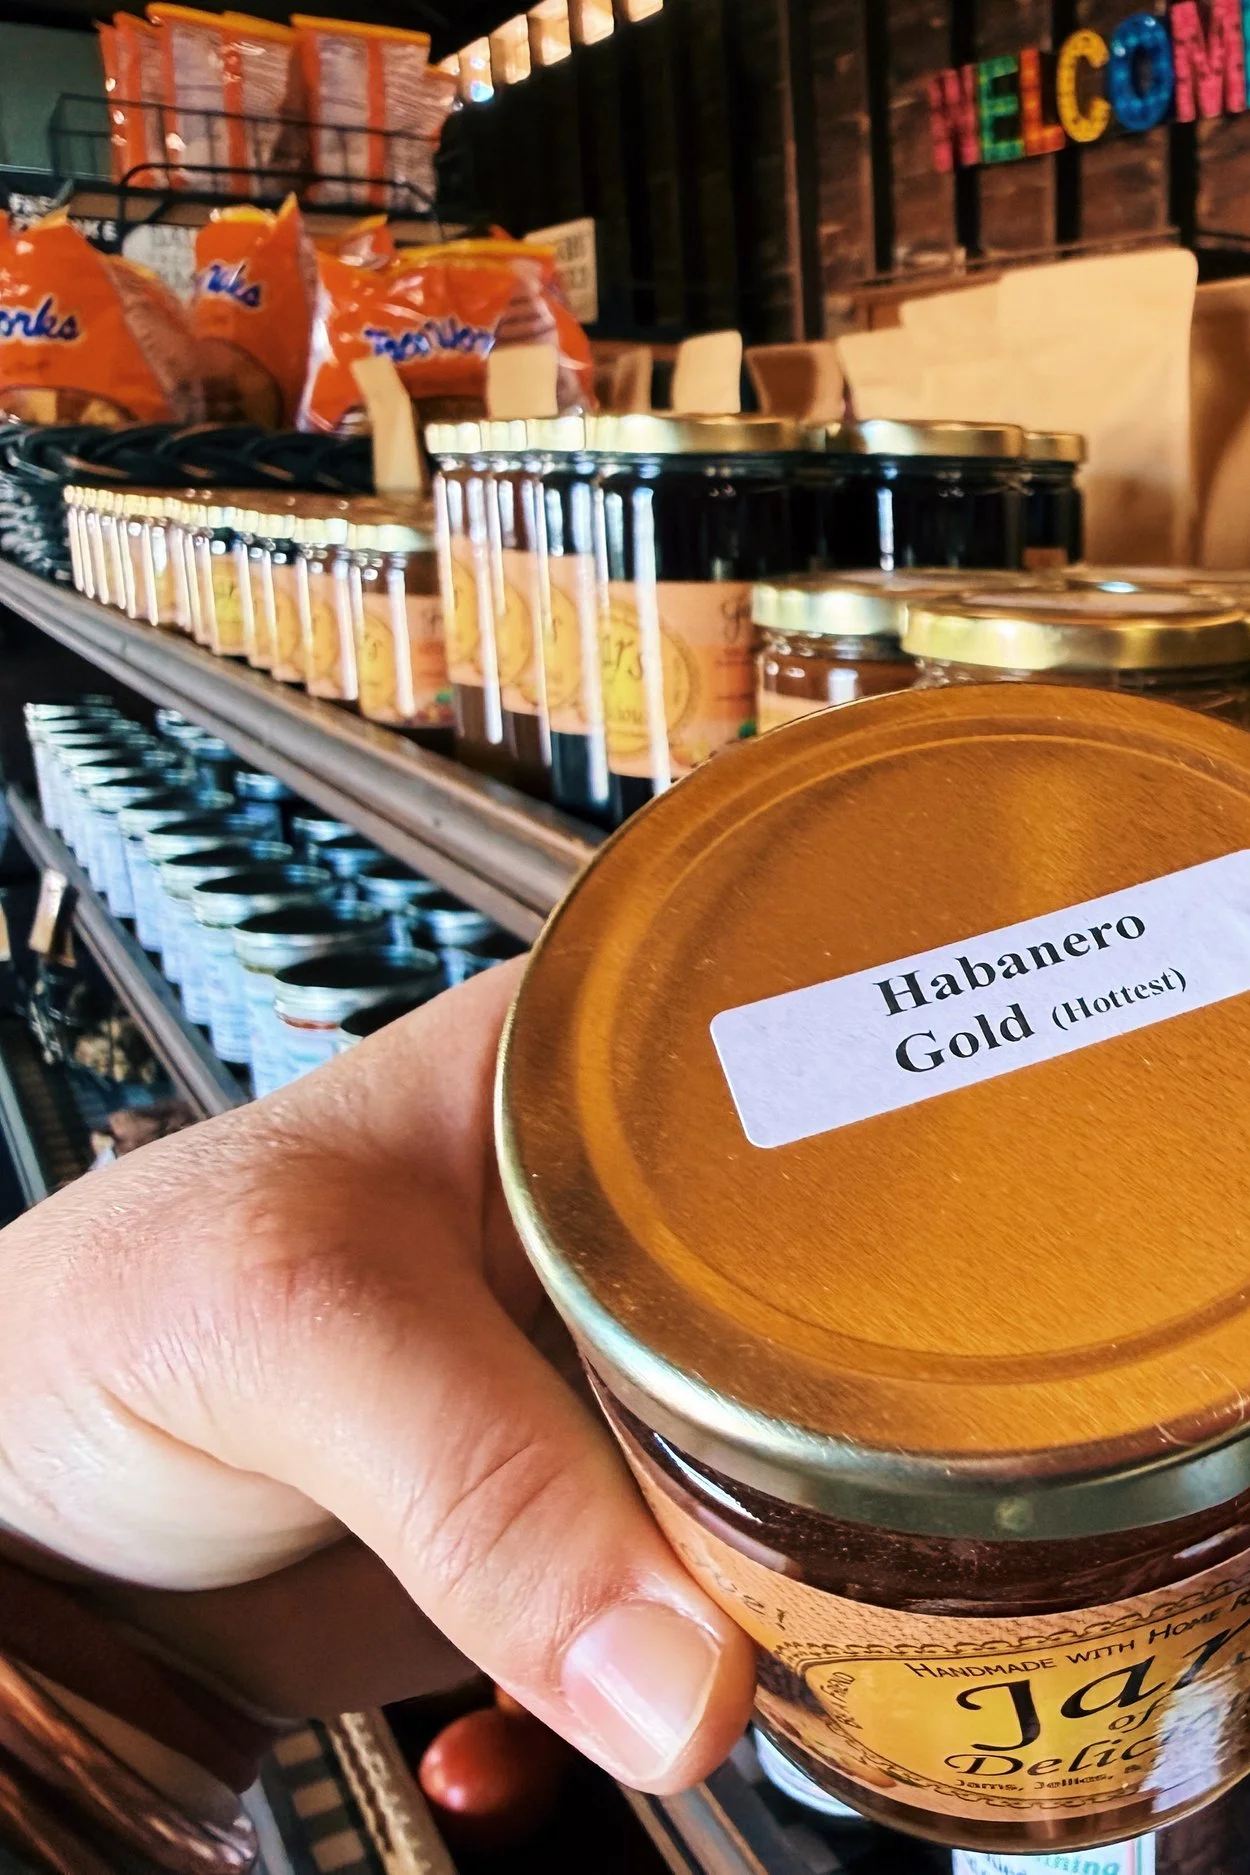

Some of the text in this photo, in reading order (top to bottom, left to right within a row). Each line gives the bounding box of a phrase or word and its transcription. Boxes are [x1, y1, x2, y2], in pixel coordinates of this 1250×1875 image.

[0, 297, 80, 341] orks
[872, 914, 1147, 1018] Habanero
[895, 967, 1188, 1074] Gold (Hottest)
[904, 1658, 1057, 1680] HANDMADE
[1065, 1639, 1136, 1664] WITH
[1148, 1609, 1220, 1646] HOME
[1109, 1692, 1172, 1734] of
